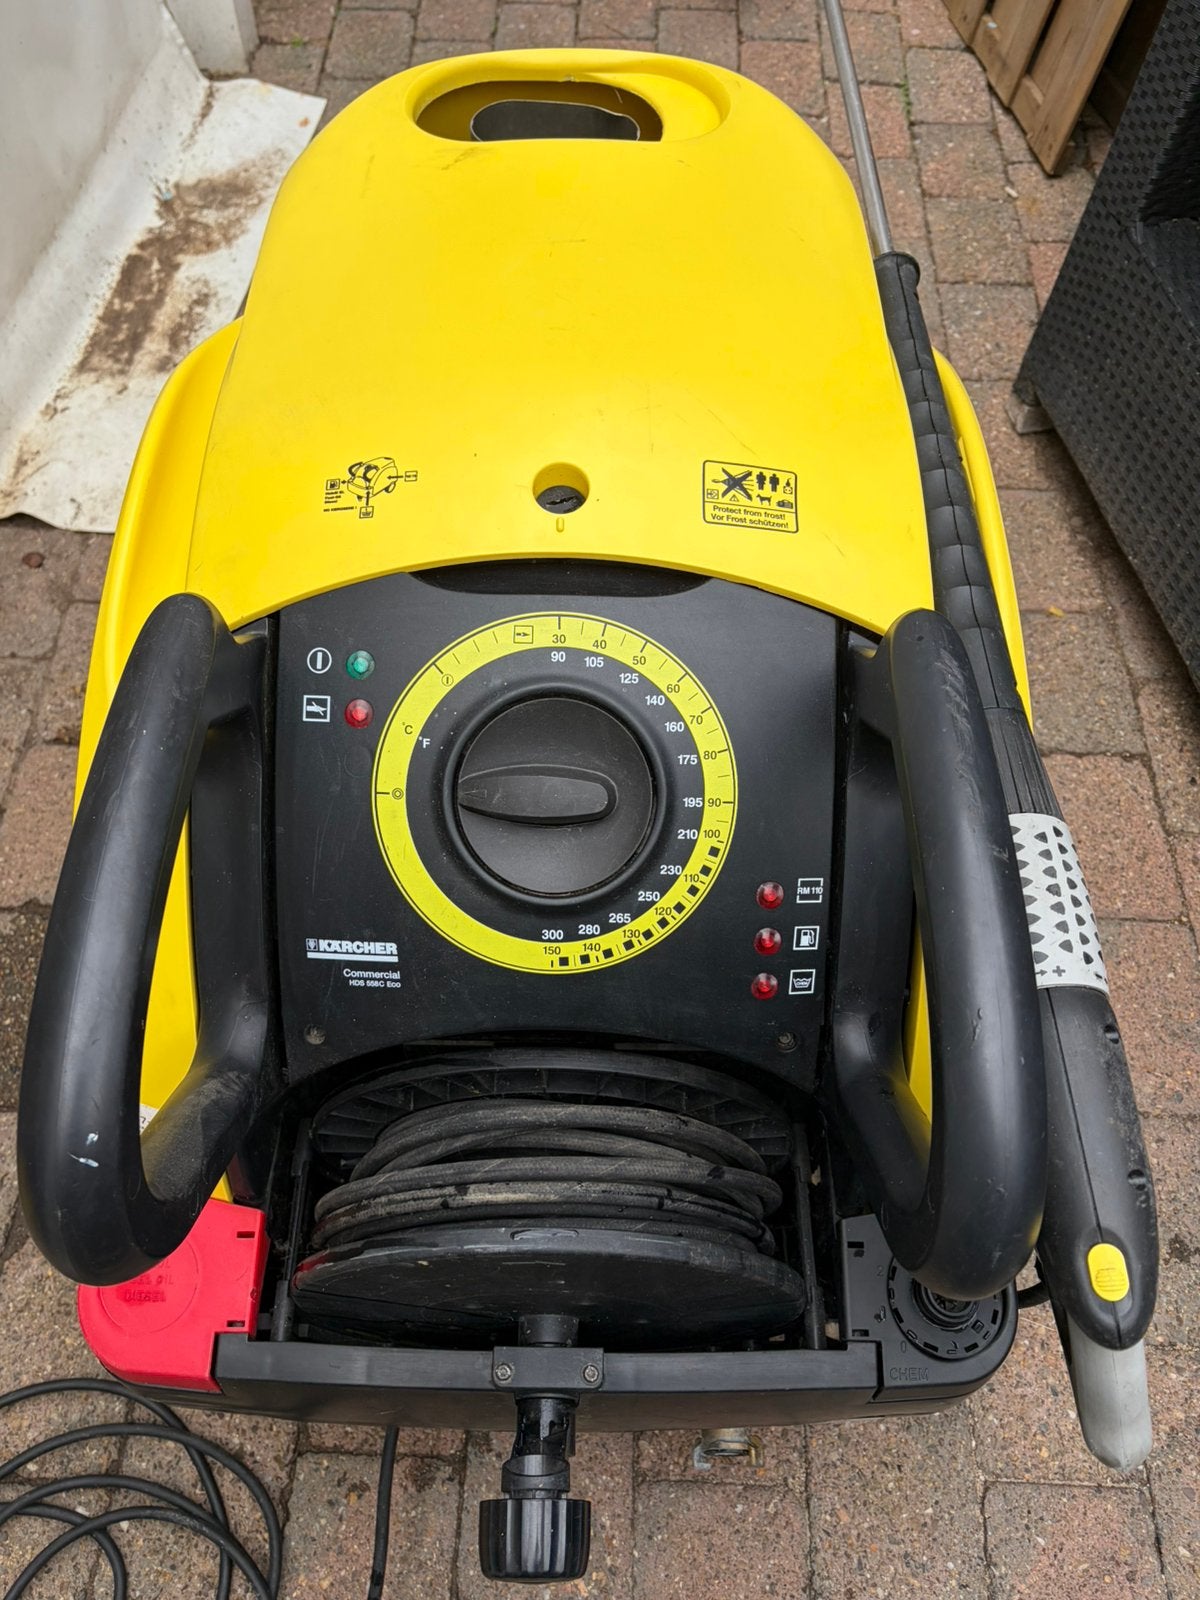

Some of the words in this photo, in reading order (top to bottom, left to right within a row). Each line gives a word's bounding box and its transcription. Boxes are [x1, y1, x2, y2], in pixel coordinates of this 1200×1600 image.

[713, 505, 741, 514] Protect
[744, 509, 762, 517] from
[764, 512, 785, 520] frost!
[727, 515, 747, 523] Frost
[749, 519, 788, 528] schützen!
[552, 634, 566, 644] 30
[593, 639, 607, 649] 40
[551, 651, 566, 662] 90
[632, 656, 646, 665] 50
[584, 657, 604, 667] 105
[619, 673, 639, 683] 125
[667, 683, 680, 693] 60
[645, 695, 665, 705] 140
[690, 715, 703, 725] 70
[665, 721, 684, 732] 160
[678, 755, 697, 765] 175
[704, 750, 717, 760] 80
[683, 797, 703, 807] 195
[707, 798, 721, 807] 90
[678, 829, 698, 839] 210
[703, 829, 720, 839] 100
[660, 865, 682, 875] 230
[683, 874, 699, 883] 110
[638, 891, 660, 902] 250
[654, 907, 672, 916] 120
[609, 913, 631, 923] 265
[542, 930, 563, 939] 300
[578, 924, 600, 935] 280
[622, 930, 640, 939] 130
[319, 939, 398, 954] KÄRCHER
[543, 946, 561, 955] 150
[582, 943, 600, 952] 140
[343, 968, 400, 979] Commercial
[890, 1368, 928, 1381] CHEM
